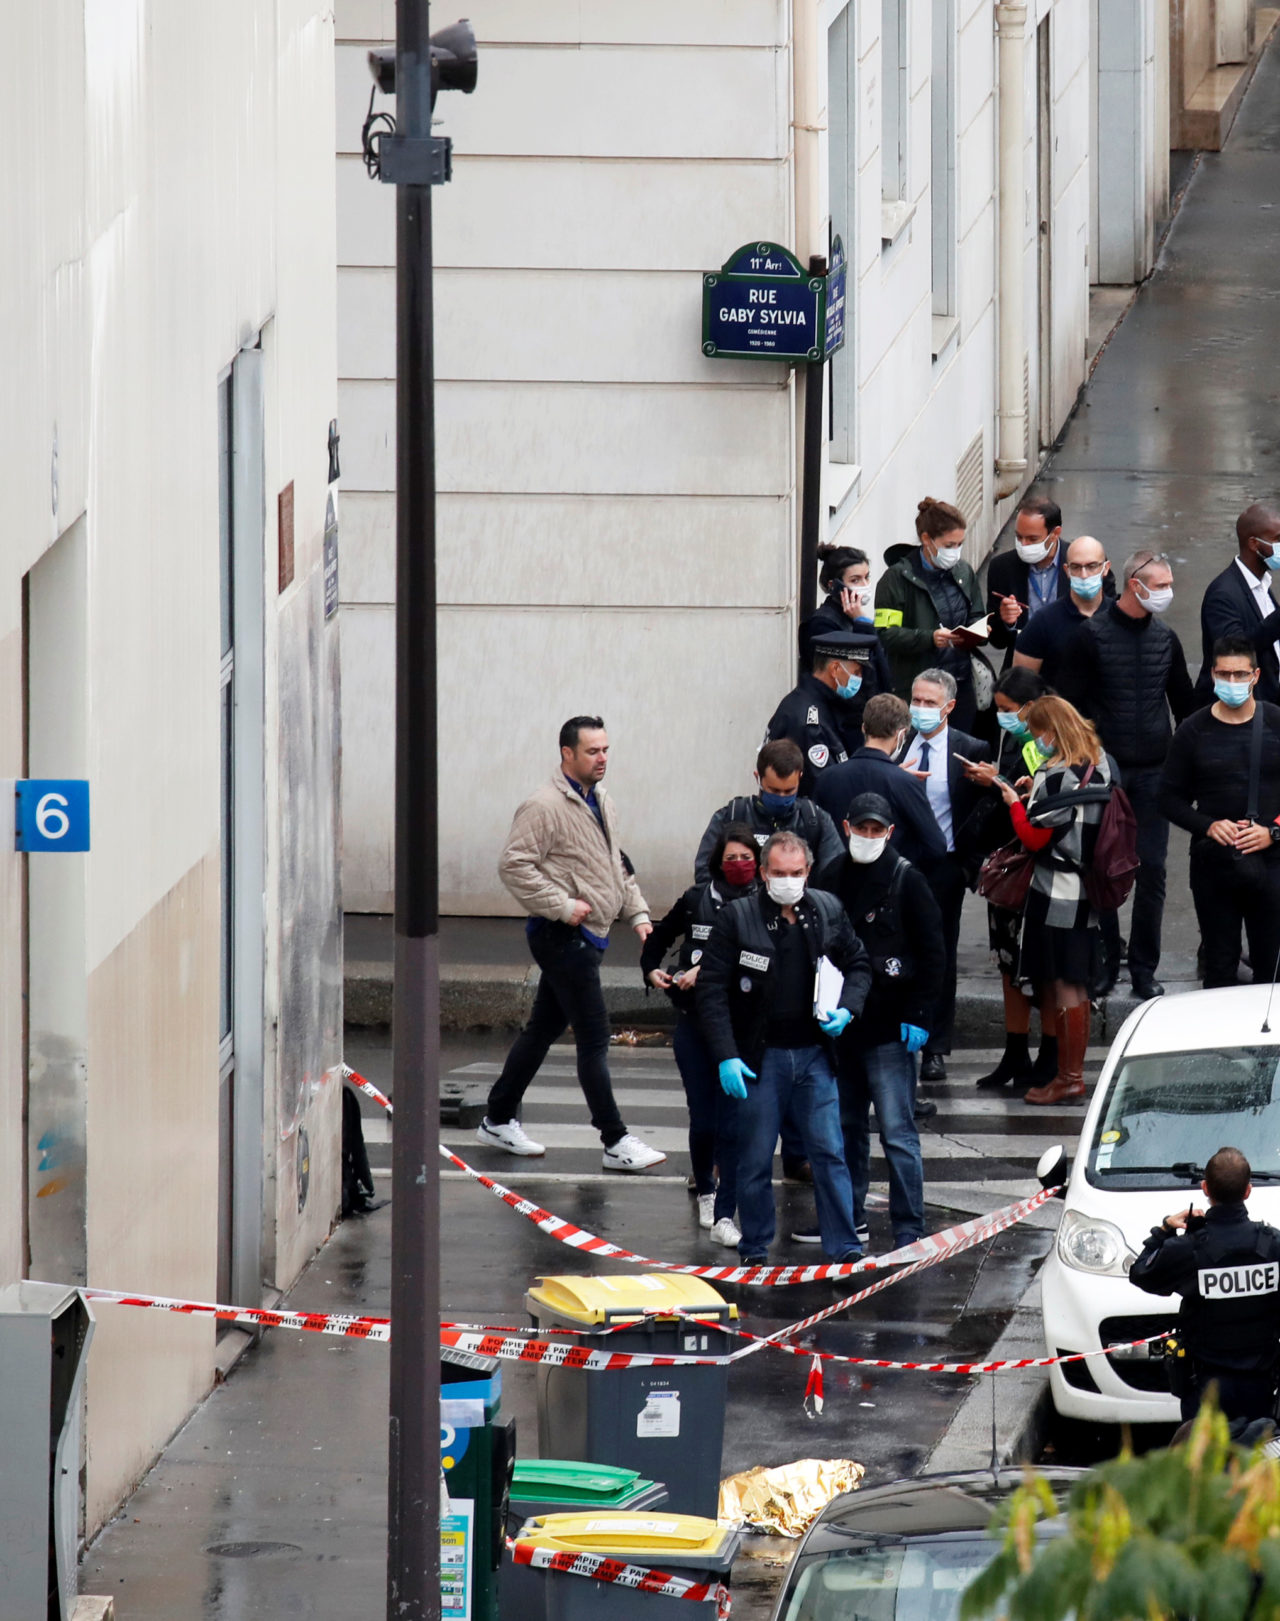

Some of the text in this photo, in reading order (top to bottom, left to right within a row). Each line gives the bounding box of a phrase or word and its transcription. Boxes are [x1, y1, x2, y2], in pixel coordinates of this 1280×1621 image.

[749, 289, 777, 304] RUE
[719, 308, 806, 325] GABY SYLVIA
[35, 792, 69, 840] 6
[741, 953, 769, 966] POLICE
[1203, 1266, 1275, 1295] POLICE
[249, 1312, 336, 1333] FRANCHISSEMENT
[338, 1324, 383, 1338] INTERDIT
[467, 1342, 599, 1368] FRANCHISSEMENT INTERDIT
[487, 1337, 581, 1357] POMPIERS DE PARIS
[561, 1551, 612, 1570] POMPIERS
[614, 1564, 626, 1574] DE
[541, 1556, 676, 1595] FRANCHISSEMENT INTERDIT
